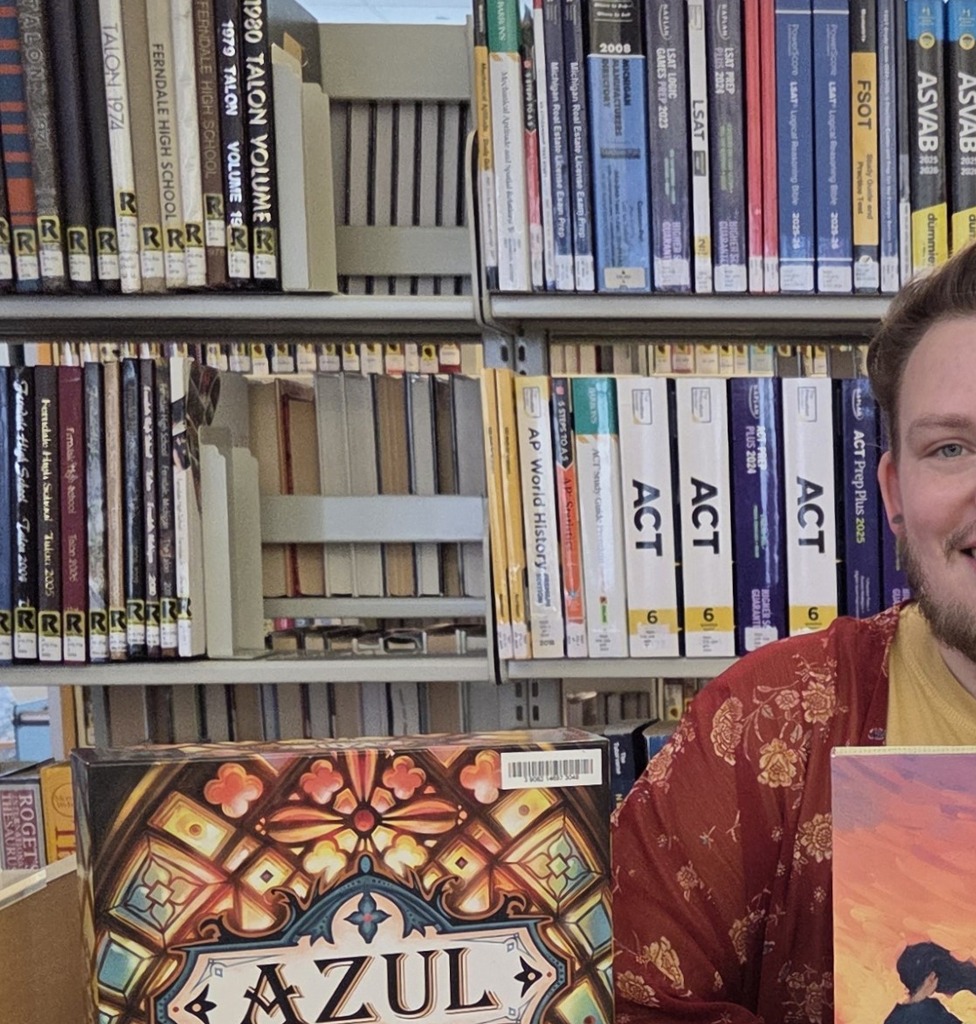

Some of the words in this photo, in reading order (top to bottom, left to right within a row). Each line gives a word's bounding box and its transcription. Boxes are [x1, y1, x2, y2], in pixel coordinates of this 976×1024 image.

[102, 23, 121, 87] TALON
[221, 18, 236, 57] 1979
[599, 43, 632, 54] 2008
[724, 48, 734, 70] LSAT
[152, 43, 169, 116] FERNDALE
[223, 64, 239, 117] TALON
[246, 51, 268, 126] TALON
[569, 61, 581, 102] Michigan
[725, 71, 736, 94] PREP
[107, 95, 126, 131] 1974
[572, 104, 583, 124] Real
[691, 100, 705, 142] LSAT
[857, 79, 872, 131] FSOT
[917, 70, 940, 154] ASVAB
[157, 118, 172, 158] HIGH
[573, 125, 584, 154] Estate
[226, 141, 243, 203] VOLUME
[249, 133, 272, 224] VOLUME
[574, 154, 586, 190] License
[160, 160, 177, 222] SCHOOL
[576, 191, 587, 216] Exam
[576, 216, 588, 238] Prep
[528, 426, 541, 454] AP
[853, 430, 866, 458] ACT
[530, 460, 543, 510] World
[854, 460, 866, 490] Prep
[632, 478, 663, 557] ACT
[690, 476, 720, 555] ACT
[796, 475, 825, 554] ACT
[855, 490, 867, 516] Plus
[533, 511, 550, 578] History
[856, 517, 866, 544] 2025
[44, 568, 55, 598] 2005
[647, 609, 658, 624] 6
[703, 608, 714, 622] 6
[808, 606, 820, 621] 6
